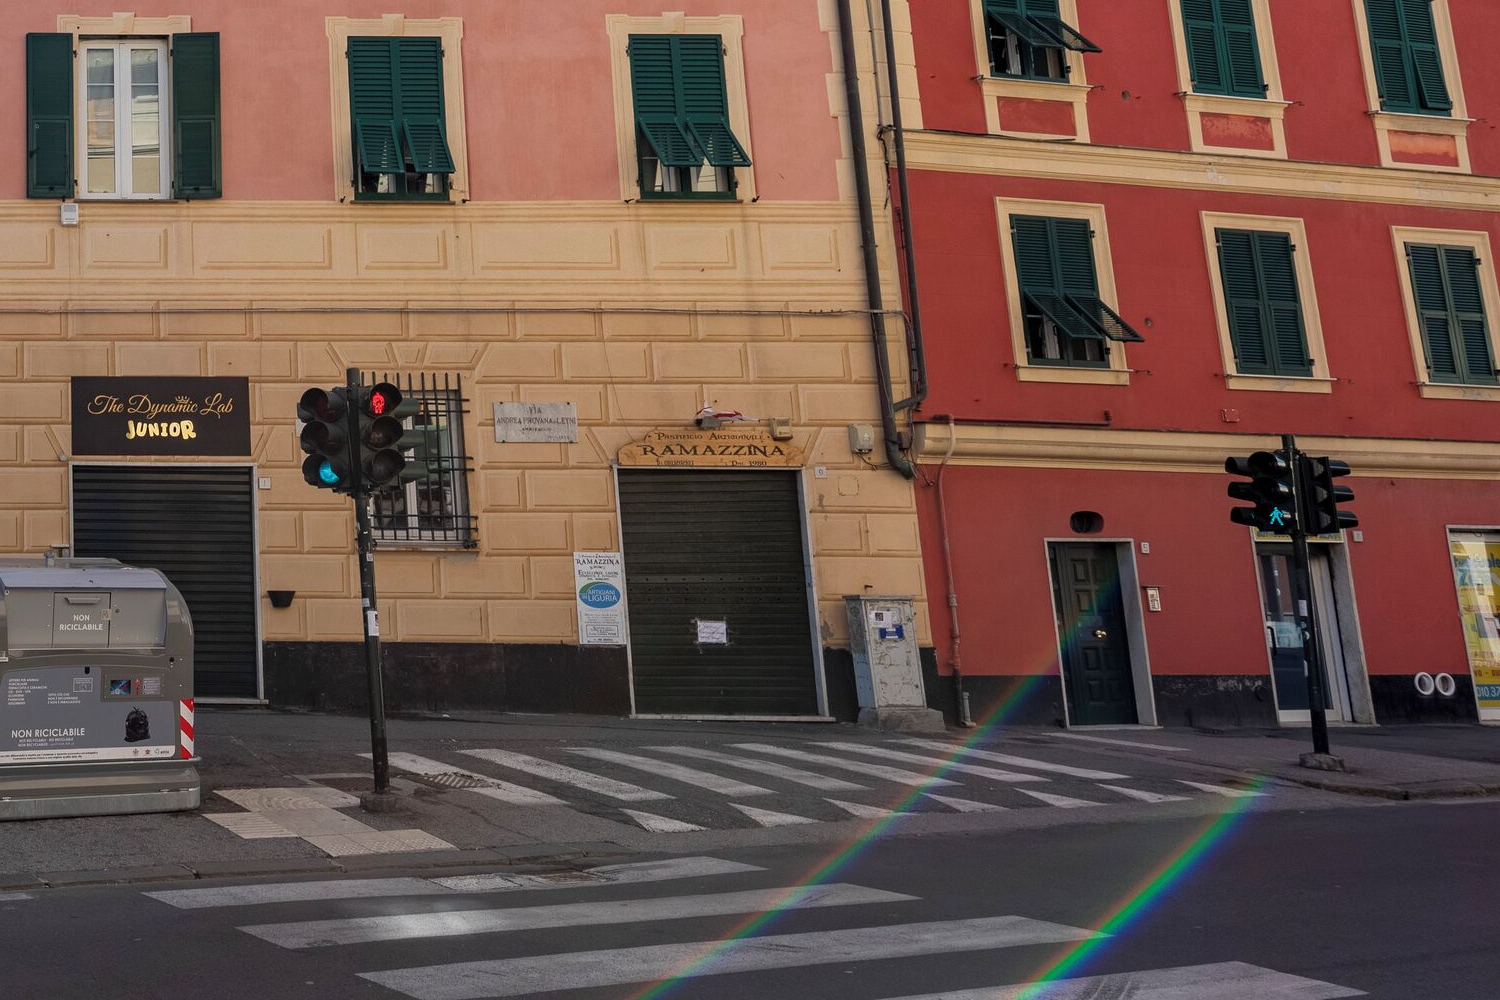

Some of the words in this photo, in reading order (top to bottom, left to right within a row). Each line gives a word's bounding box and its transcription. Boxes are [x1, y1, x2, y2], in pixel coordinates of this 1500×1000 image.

[88, 395, 124, 415] The
[127, 394, 198, 420] Dynamic
[200, 393, 234, 419] Lab
[528, 404, 542, 414] VIA
[497, 417, 522, 425] ANDREA
[126, 420, 197, 440] JUNIOR
[636, 444, 785, 458] RAMAZZINA
[575, 558, 620, 566] RAMAZZINA
[588, 594, 618, 602] LIGURIA
[73, 614, 90, 622] NON
[59, 623, 104, 631] RICICLABILE
[11, 729, 32, 738] NON
[34, 727, 85, 737] RICICLABILE
